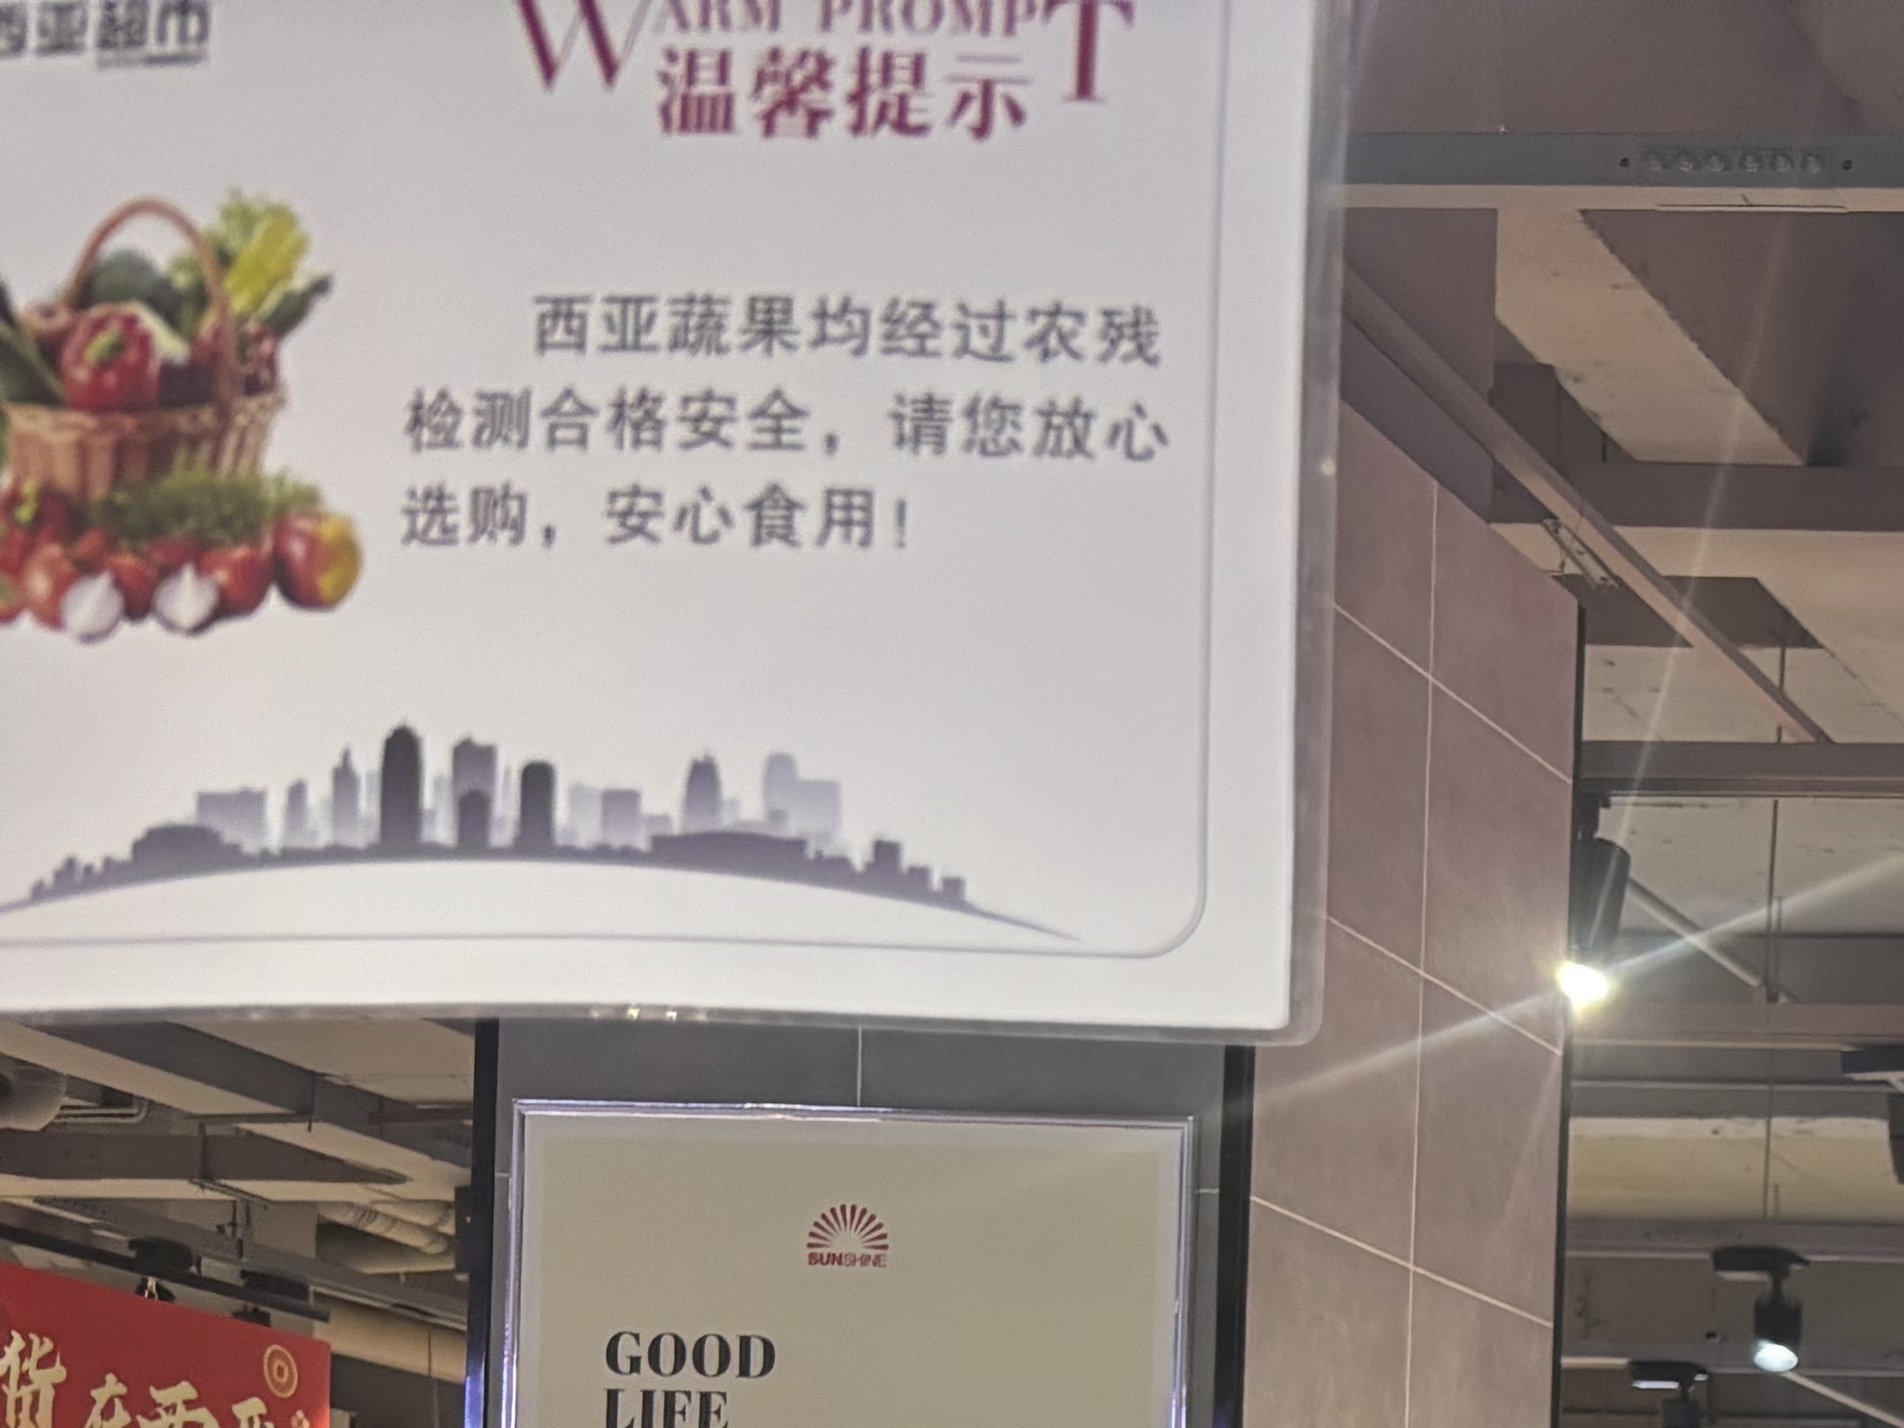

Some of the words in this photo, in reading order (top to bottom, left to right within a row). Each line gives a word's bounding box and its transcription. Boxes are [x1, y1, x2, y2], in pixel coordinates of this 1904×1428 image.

[655, 47, 1033, 140] 温馨提示
[532, 293, 1163, 368] 西亚蔬果均经过农残
[402, 385, 1169, 462] 检测合格安全，请您放心
[807, 1252, 888, 1269] SUNSHINE
[604, 1330, 777, 1380] GOOD
